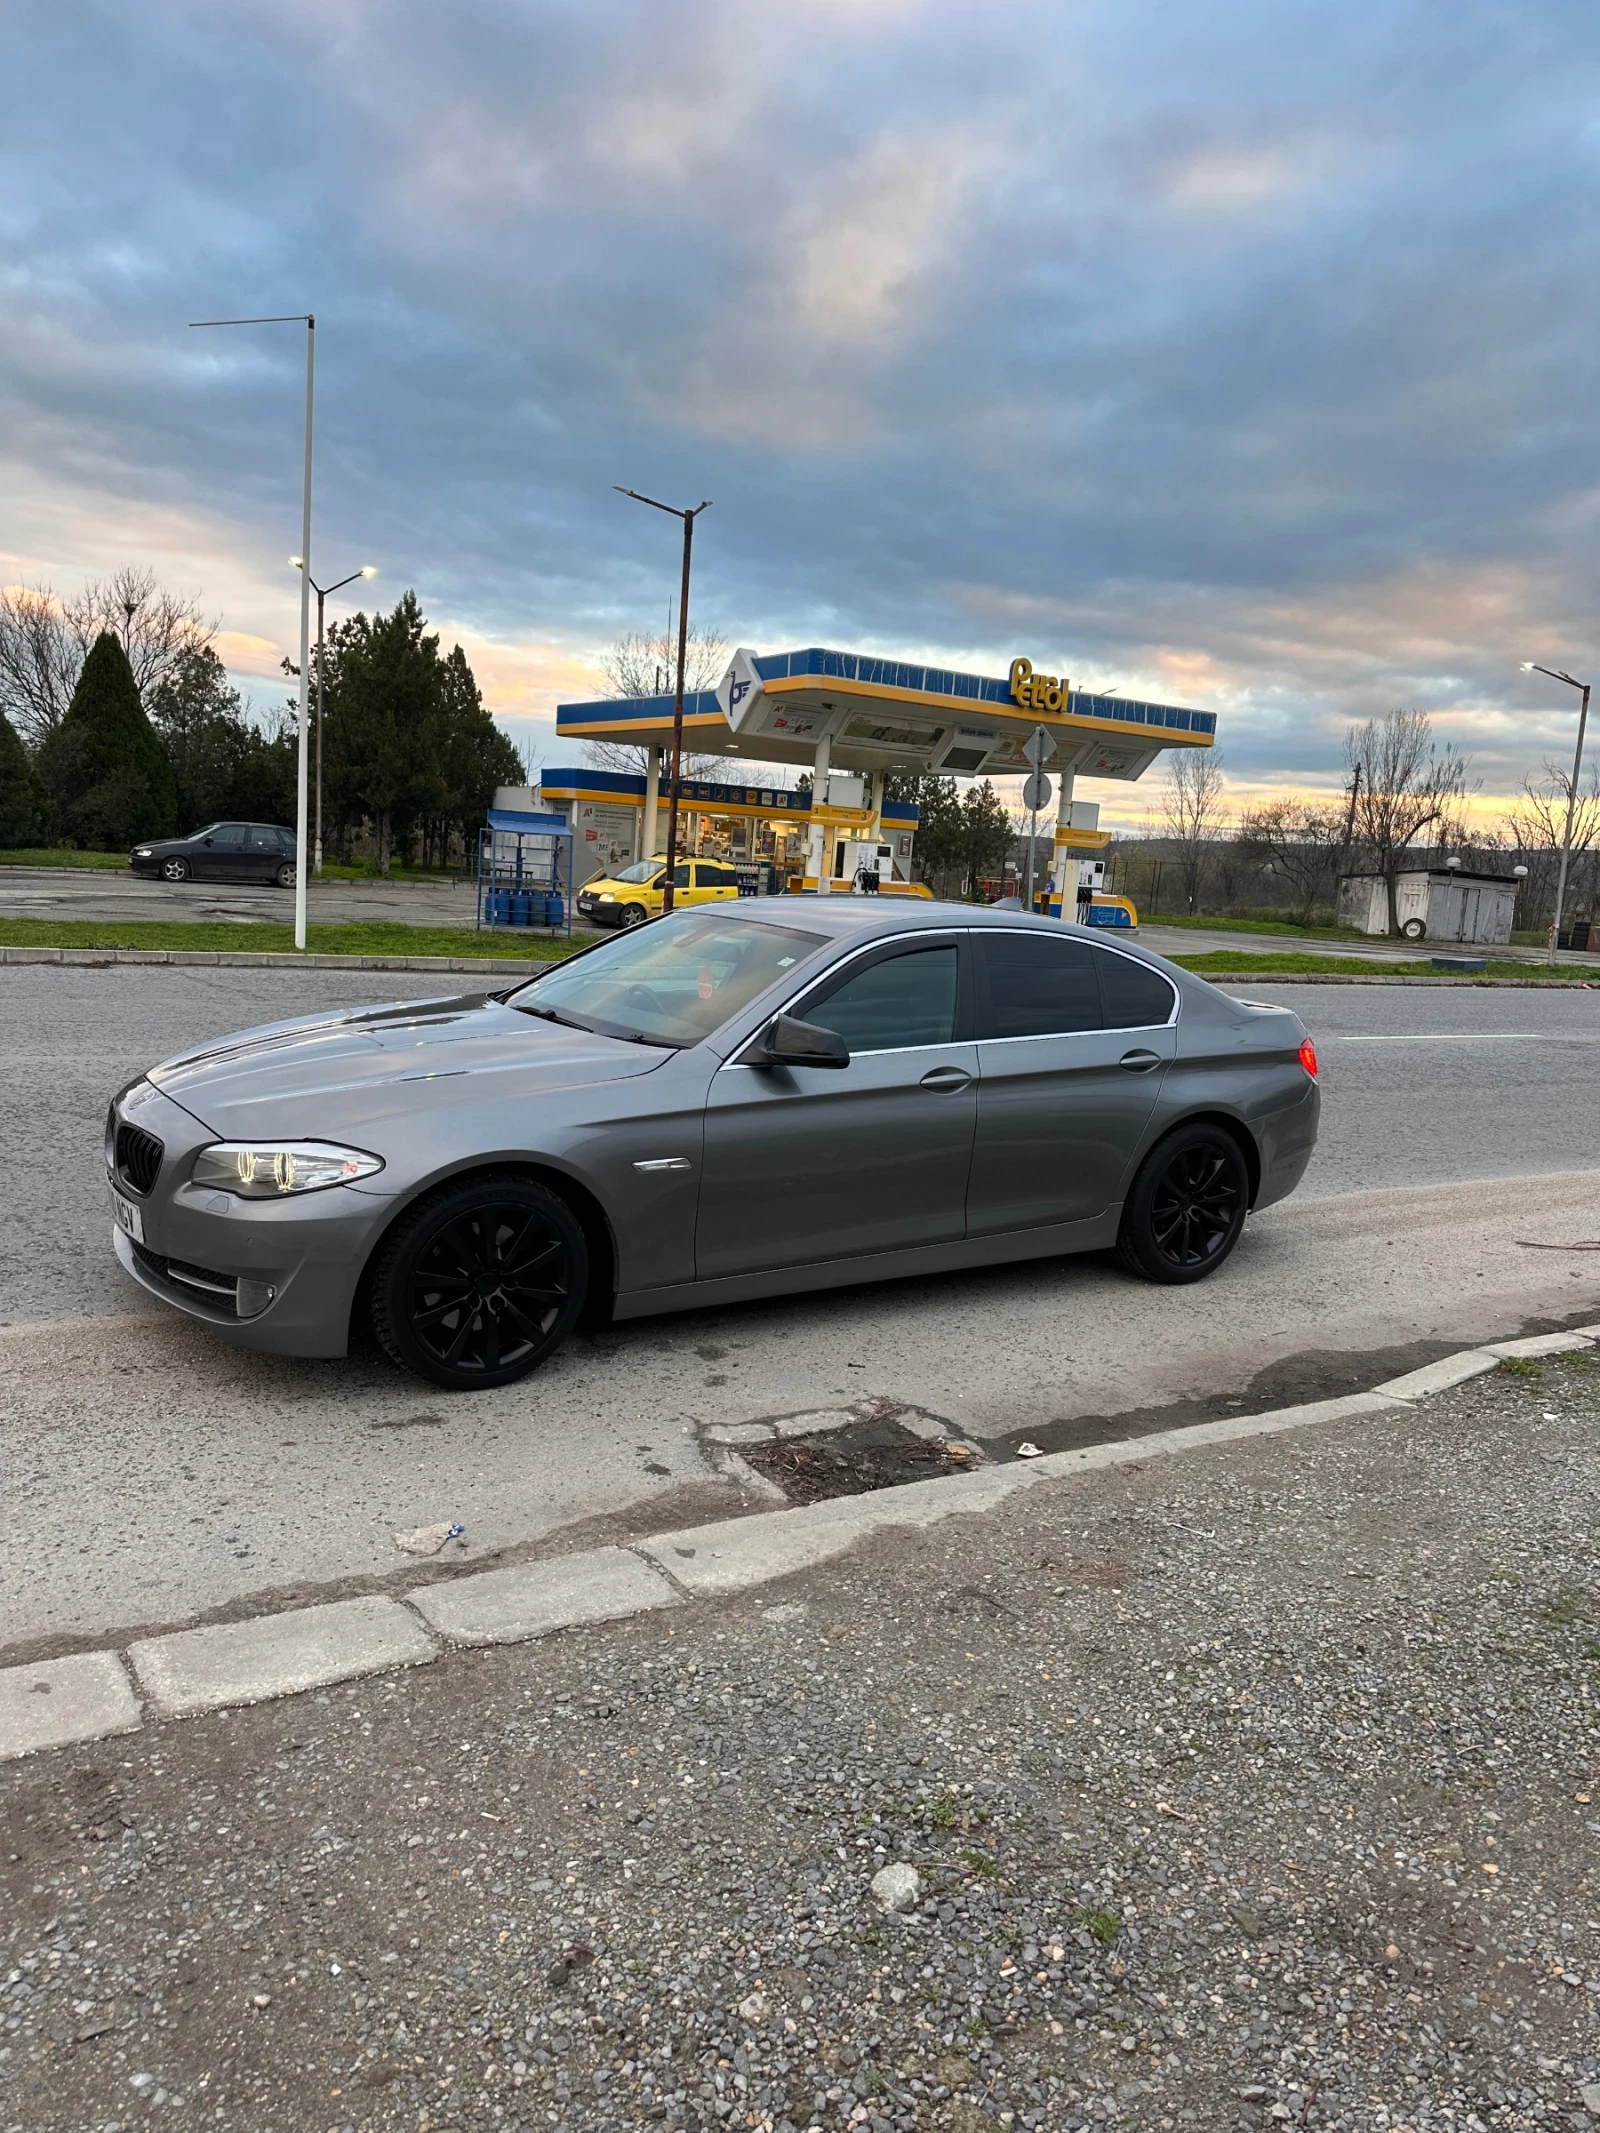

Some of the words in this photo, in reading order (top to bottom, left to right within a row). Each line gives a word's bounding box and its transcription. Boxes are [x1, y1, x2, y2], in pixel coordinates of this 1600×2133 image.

[1009, 657, 1070, 712] Petrol
[583, 807, 593, 817] A1
[861, 811, 867, 820] 3
